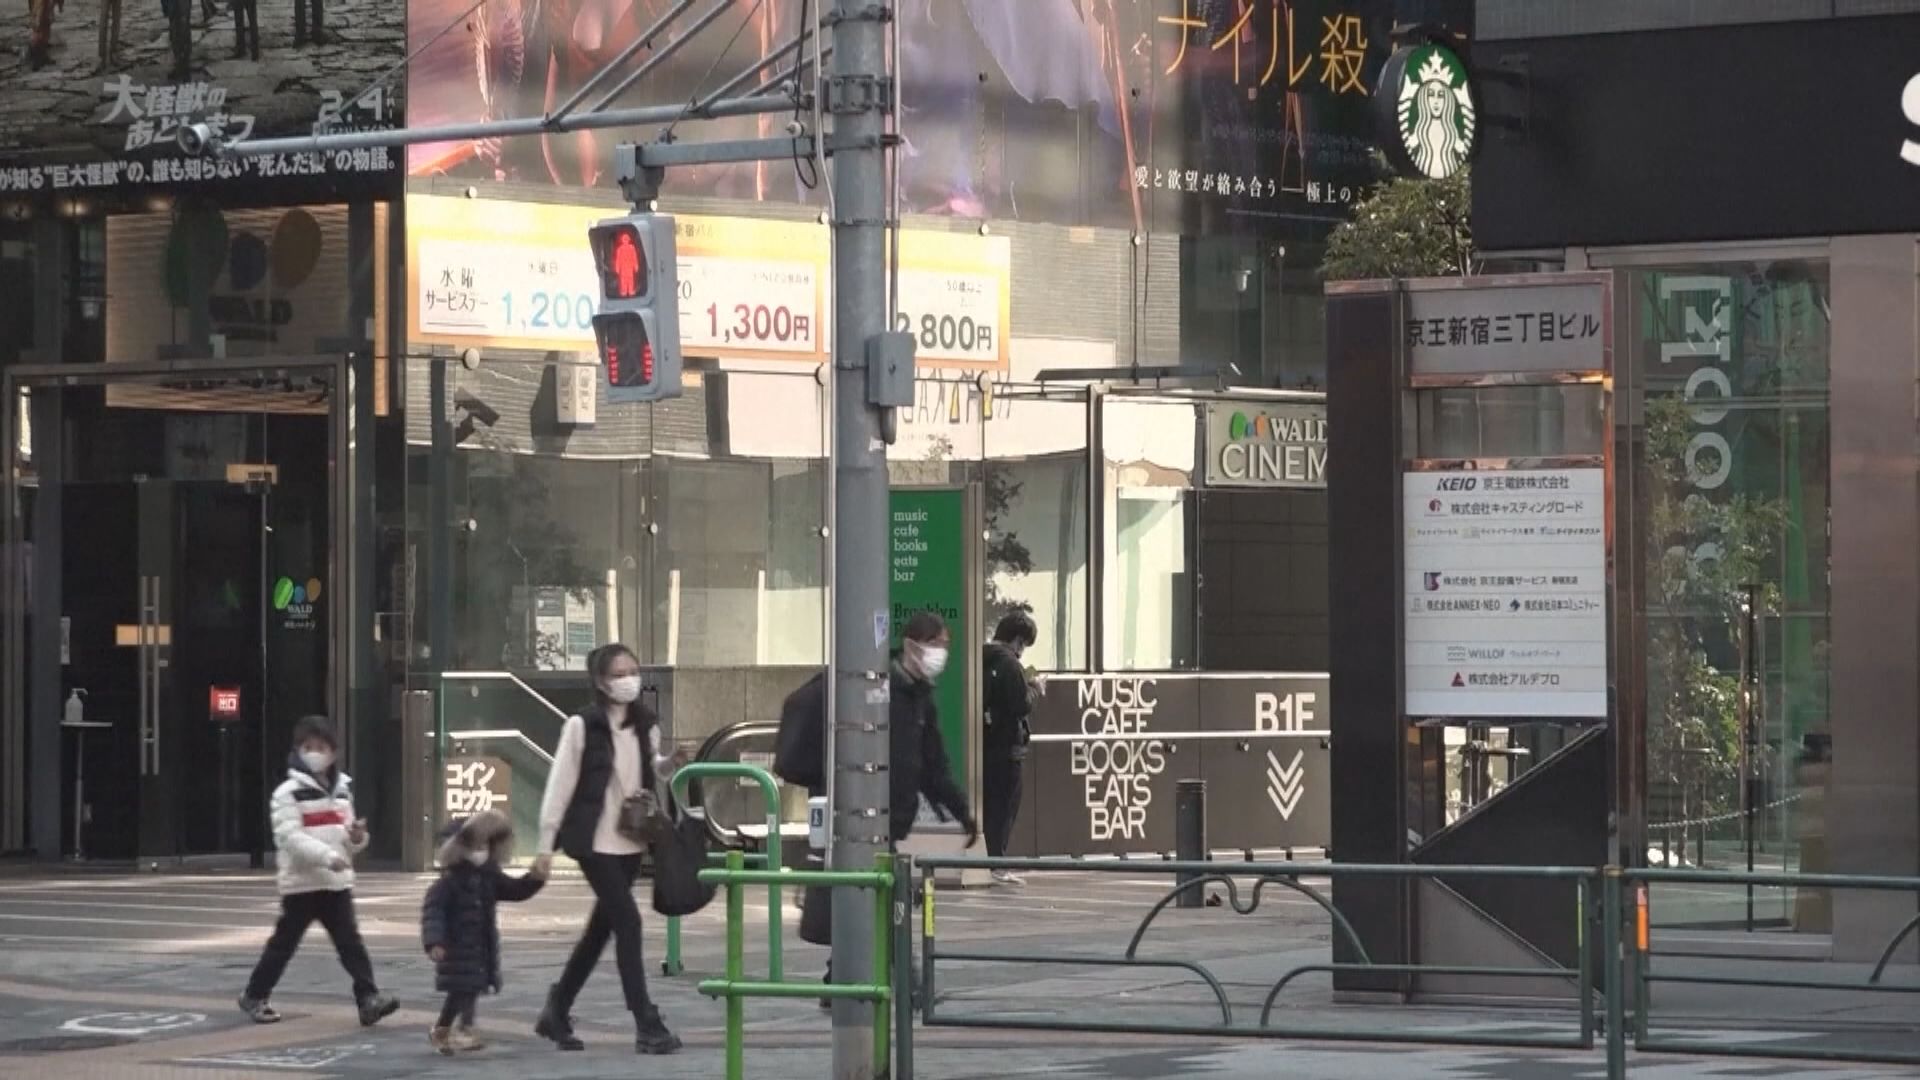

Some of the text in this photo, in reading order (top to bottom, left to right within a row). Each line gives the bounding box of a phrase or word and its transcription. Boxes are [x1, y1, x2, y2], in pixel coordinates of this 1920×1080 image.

[1157, 0, 1368, 96] ナイル殺
[100, 73, 228, 124] 大怪獣の
[124, 112, 256, 152] あとまつ
[706, 302, 809, 343] 1,300円
[1405, 312, 1600, 348] 京王新宿三丁目ビル
[1436, 476, 1570, 491] KEIO 京王電鉄株式会社
[894, 508, 928, 522] music
[1451, 501, 1583, 515] 株式会社キャスティングロード
[894, 524, 919, 538] cafe
[894, 539, 928, 552] books
[894, 554, 918, 568] eats
[894, 568, 915, 582] bar
[1444, 576, 1477, 586] 株式会社
[1468, 673, 1560, 685] 株式会社アルデプロ
[1077, 678, 1158, 709] MUSIC
[1080, 708, 1154, 735] CAFE
[1255, 692, 1316, 732] B1F
[1071, 740, 1166, 775] BOOKS
[446, 761, 496, 787] コイン
[446, 786, 508, 812] ロッカー
[1085, 774, 1152, 808] EATS
[1090, 806, 1146, 840] BAR
